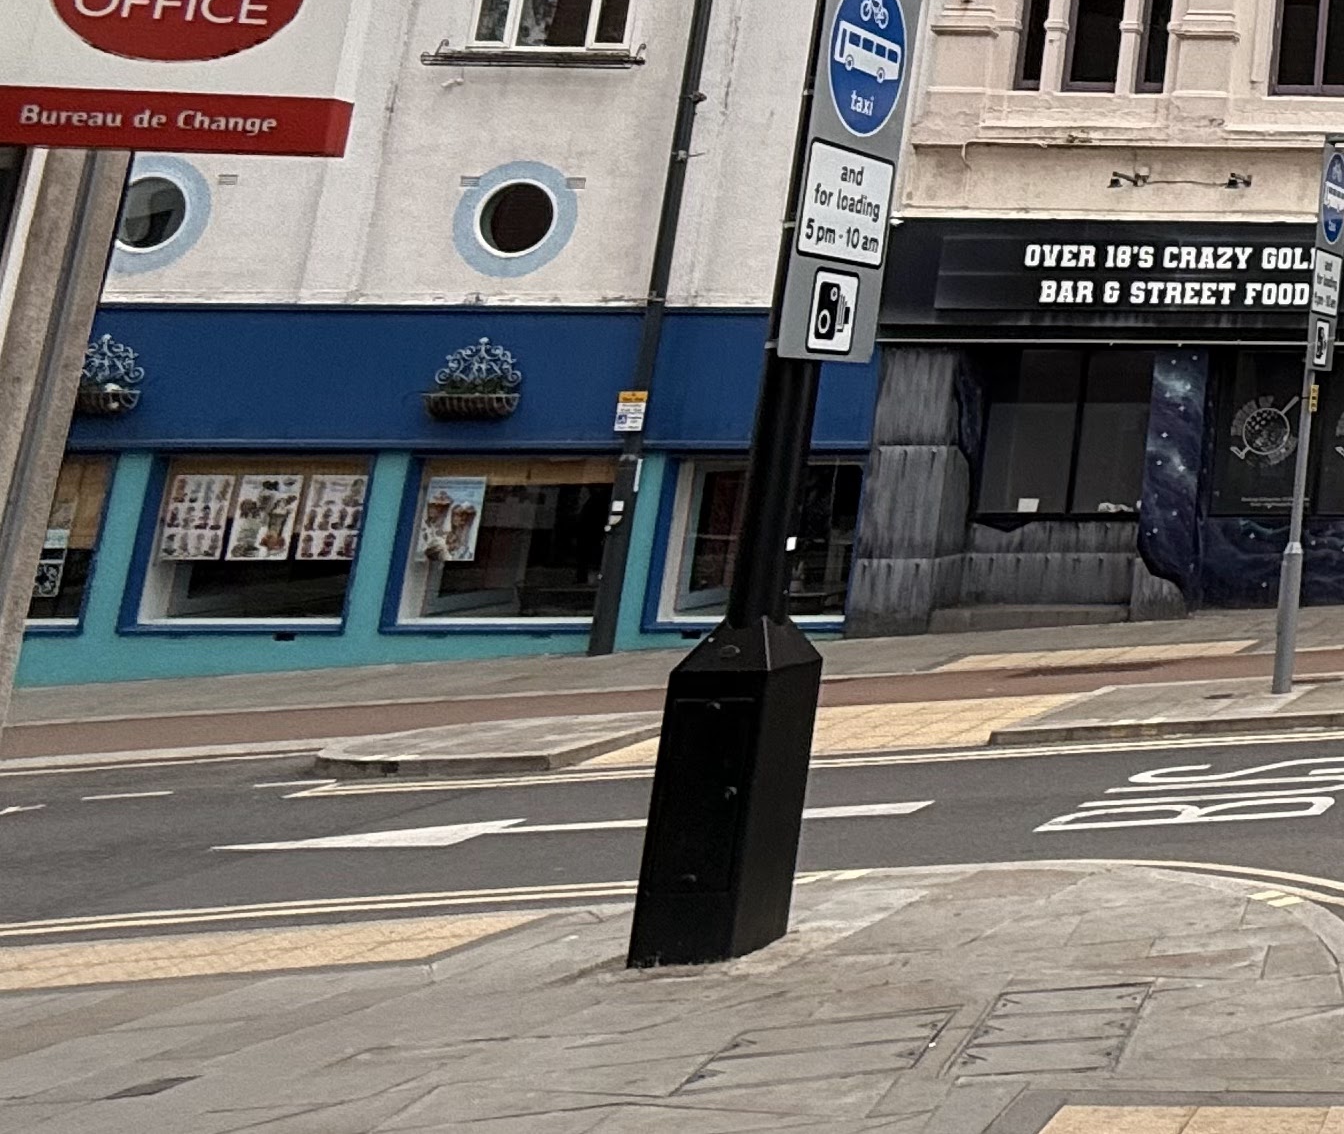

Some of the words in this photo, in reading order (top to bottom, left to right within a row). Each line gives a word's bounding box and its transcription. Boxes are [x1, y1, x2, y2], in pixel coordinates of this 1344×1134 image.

[850, 90, 875, 116] taxi
[19, 104, 122, 128] Bureau
[133, 109, 166, 129] de
[176, 109, 278, 136] Change
[840, 165, 865, 186] and
[814, 182, 834, 207] for
[836, 188, 881, 223] loading
[1024, 244, 1097, 268] OVER
[1105, 245, 1155, 268] 18'S
[1163, 246, 1253, 270] CRAZY
[1039, 280, 1095, 304] BAR
[1103, 280, 1120, 304] &
[1129, 281, 1236, 305] STREET
[1244, 282, 1310, 306] FOOD
